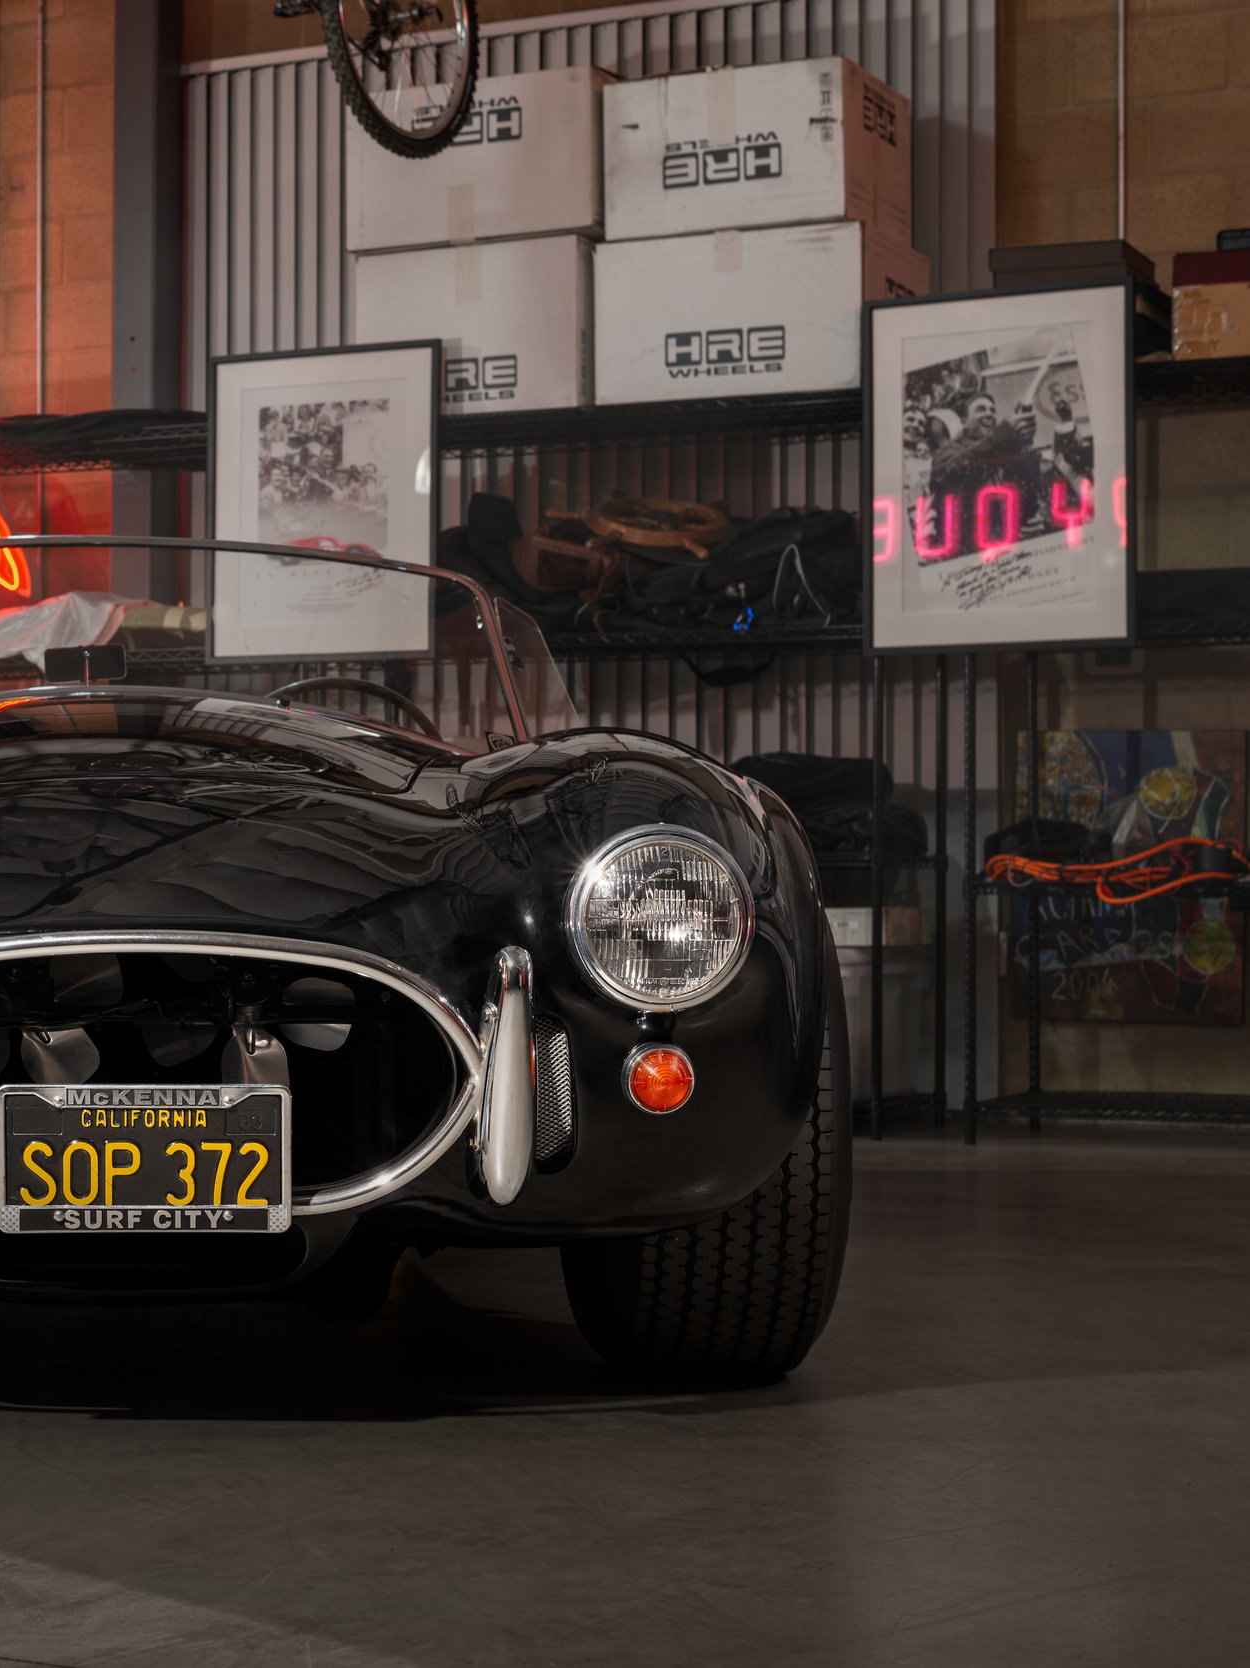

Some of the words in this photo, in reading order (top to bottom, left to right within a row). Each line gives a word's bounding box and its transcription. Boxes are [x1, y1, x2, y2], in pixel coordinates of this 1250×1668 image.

[665, 131, 778, 153] WHELS
[662, 142, 783, 191] HRE
[664, 325, 786, 368] HRE
[668, 362, 783, 379] WHEELS
[68, 1089, 219, 1107] McKENNA
[81, 1109, 208, 1128] CALIFORNIA
[19, 1141, 142, 1207] SOP
[165, 1142, 270, 1207] 372
[63, 1209, 142, 1230] SURF
[153, 1209, 224, 1230] CITY
